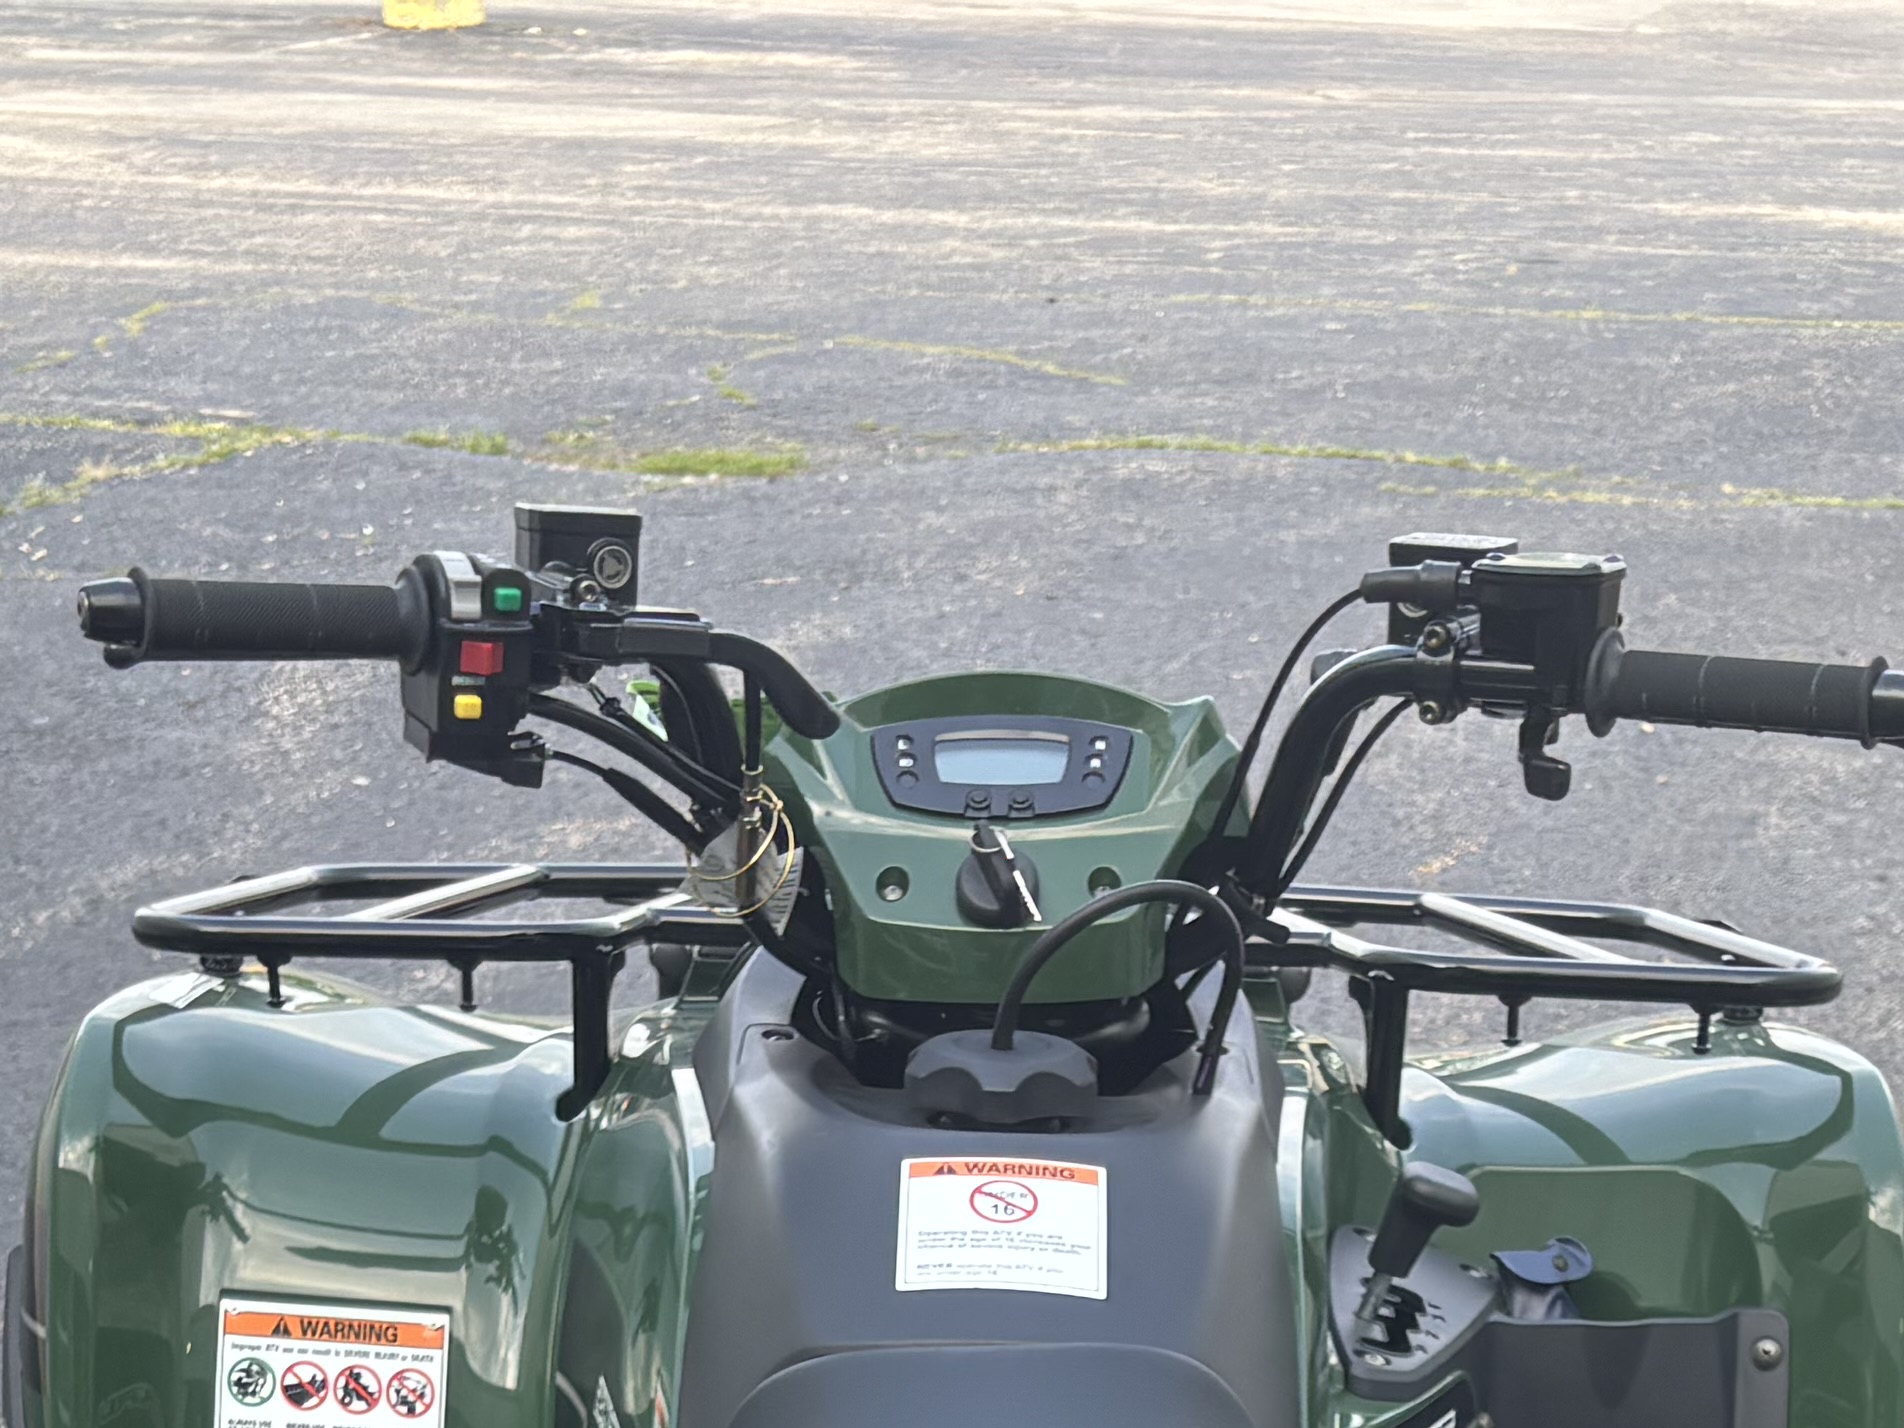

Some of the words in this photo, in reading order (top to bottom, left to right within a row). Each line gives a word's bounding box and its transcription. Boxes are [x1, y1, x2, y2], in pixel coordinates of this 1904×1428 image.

[964, 1162, 1076, 1180] WARNING
[990, 1203, 1015, 1216] 16
[300, 1319, 398, 1343] WARNING
